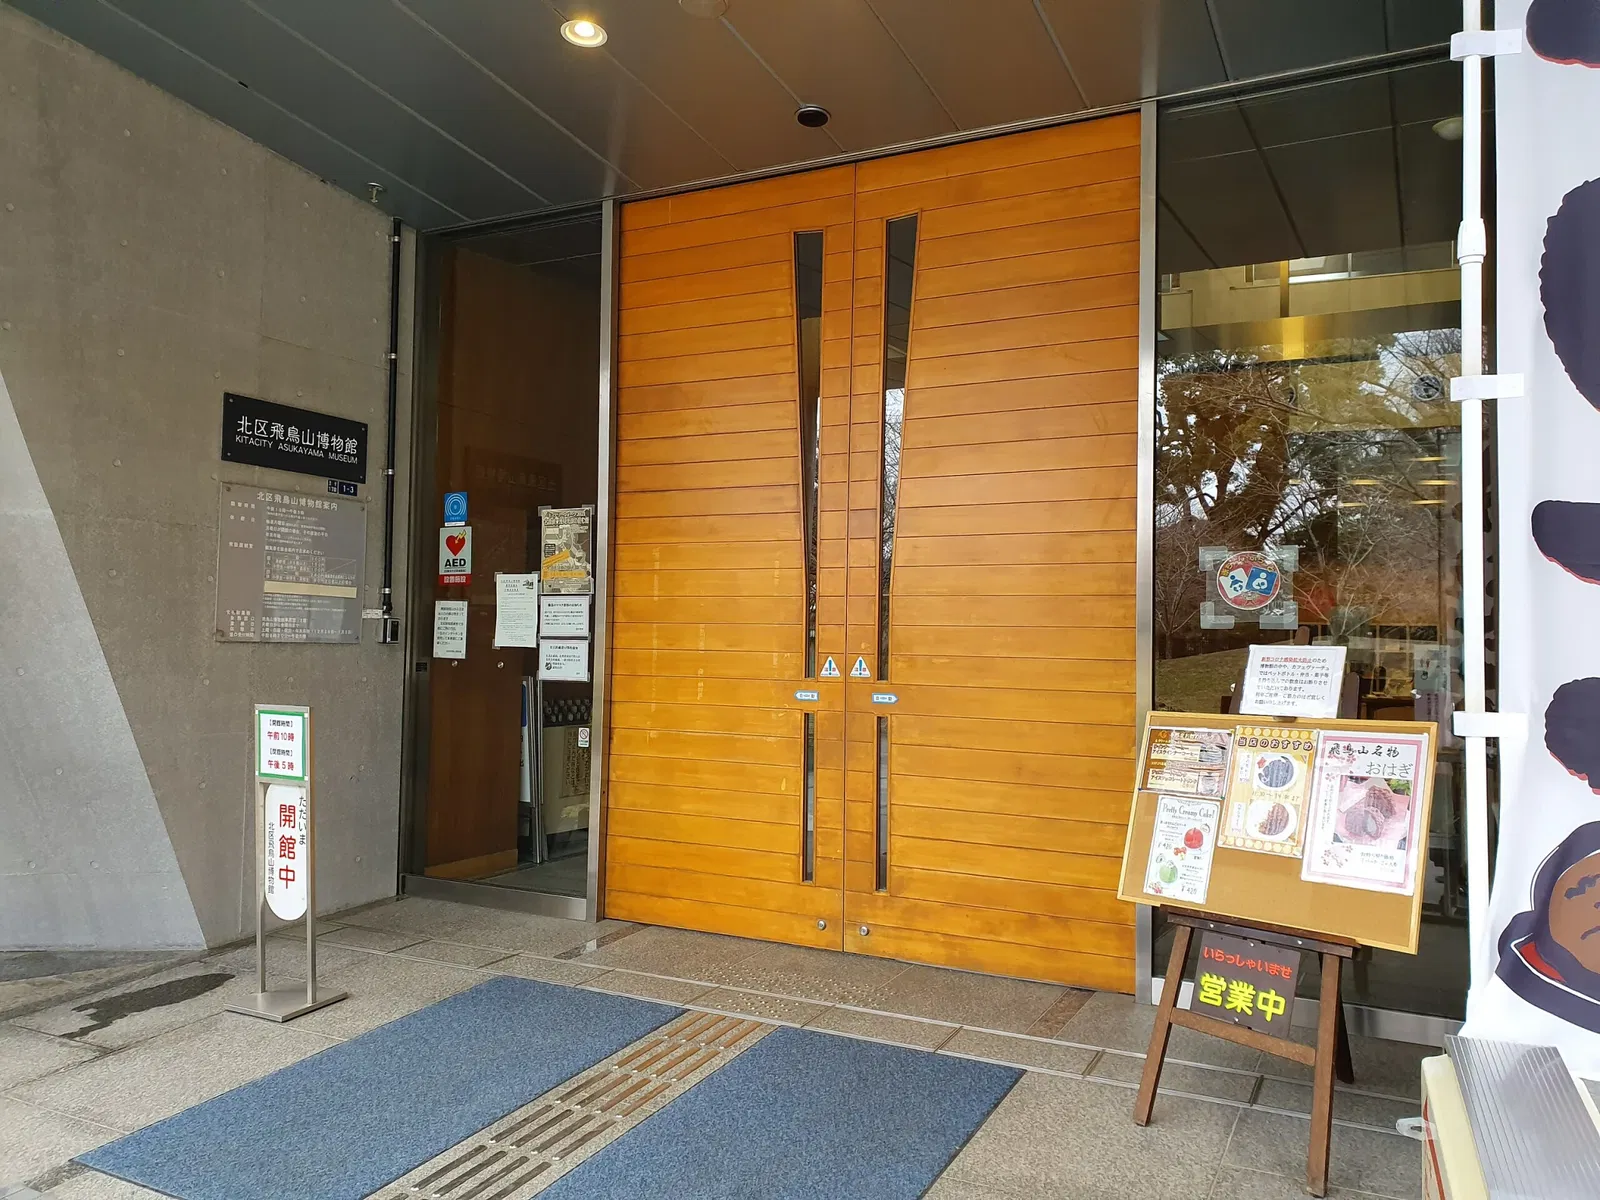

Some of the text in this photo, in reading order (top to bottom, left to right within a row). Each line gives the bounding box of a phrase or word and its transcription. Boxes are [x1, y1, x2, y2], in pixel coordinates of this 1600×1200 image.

[237, 415, 358, 455] 北区飛鳥山博物館
[235, 434, 358, 464] KITACITY ASUKAYAMA MUSEUM
[342, 485, 354, 494] 1-3
[257, 491, 338, 511] 北区飛鳥山博物館案内
[444, 558, 467, 568] AED
[267, 731, 295, 742] 午前10時
[1238, 737, 1314, 751] 当店のおすすめ
[1328, 742, 1400, 758] 飛鳥山名物
[267, 759, 295, 771] 午後5時
[1365, 761, 1413, 778] おはぎ
[278, 804, 297, 889] 開館中
[1203, 946, 1293, 979] いらっしゃいませ
[1199, 972, 1286, 1022] 営業中
